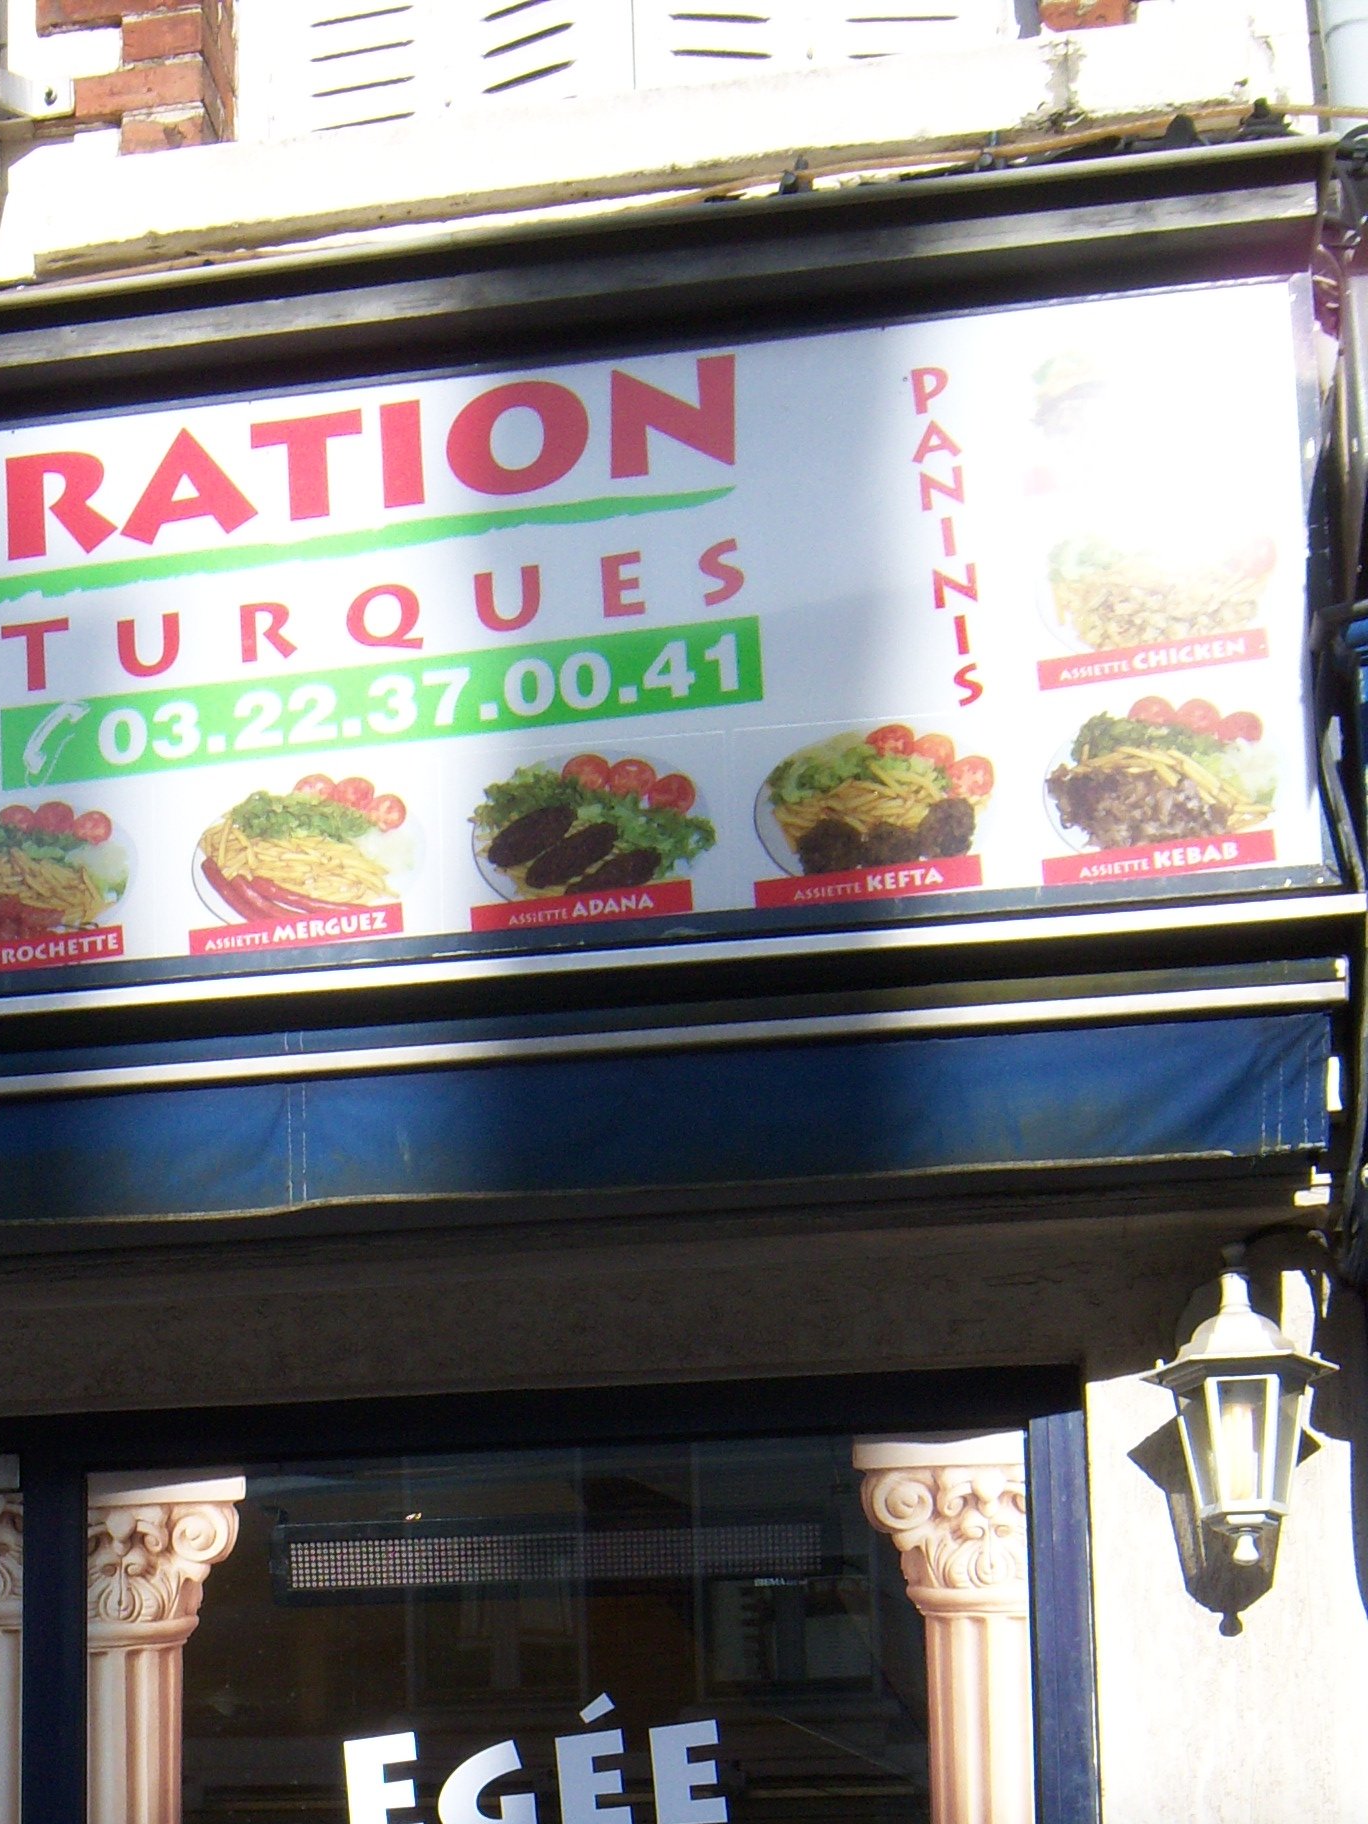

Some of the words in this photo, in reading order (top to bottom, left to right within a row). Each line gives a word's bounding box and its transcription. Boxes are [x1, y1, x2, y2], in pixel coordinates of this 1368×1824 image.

[911, 367, 984, 707] PANINIS
[2, 541, 743, 690] TURQUES
[1132, 637, 1246, 670] CHICKEN
[97, 634, 741, 766] 03.22.37.00.41
[1079, 858, 1150, 879] ASSIETTE
[1153, 842, 1240, 869] KEBAB
[793, 881, 862, 902] ASSIETTE
[866, 866, 944, 892] KEFTA
[508, 906, 570, 926] ASSIETTE
[572, 893, 655, 919] ADANA
[204, 931, 270, 952] ASSIETTE
[272, 911, 388, 943] MERGUEZ
